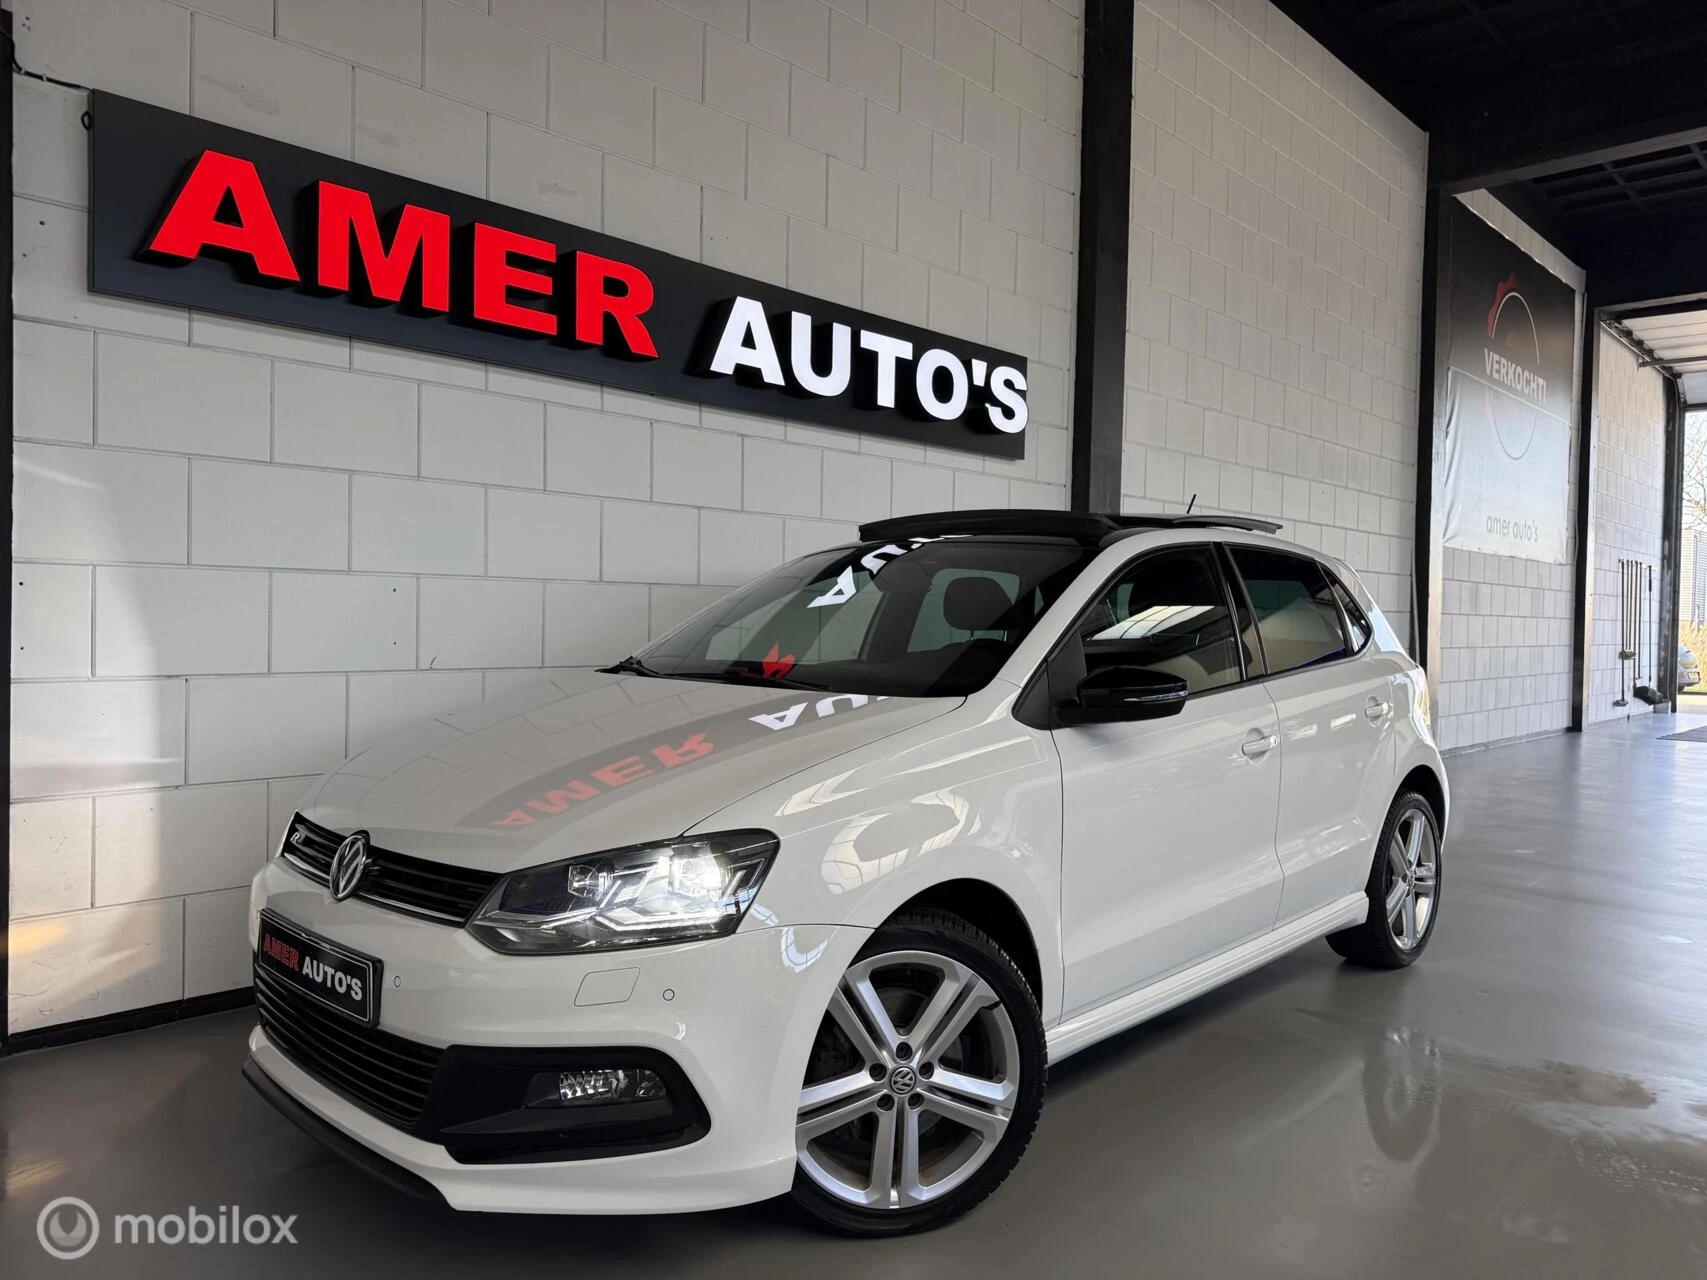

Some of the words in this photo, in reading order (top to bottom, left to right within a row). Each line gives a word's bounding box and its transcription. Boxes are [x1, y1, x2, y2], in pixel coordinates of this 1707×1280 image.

[150, 149, 660, 358] AMER
[709, 296, 1029, 435] AUTO'S
[1484, 348, 1547, 403] VERKOCHT!
[1486, 515, 1511, 536] amer
[1512, 519, 1539, 543] auto's
[263, 934, 299, 971] AMER
[302, 955, 363, 1001] AUTO'S
